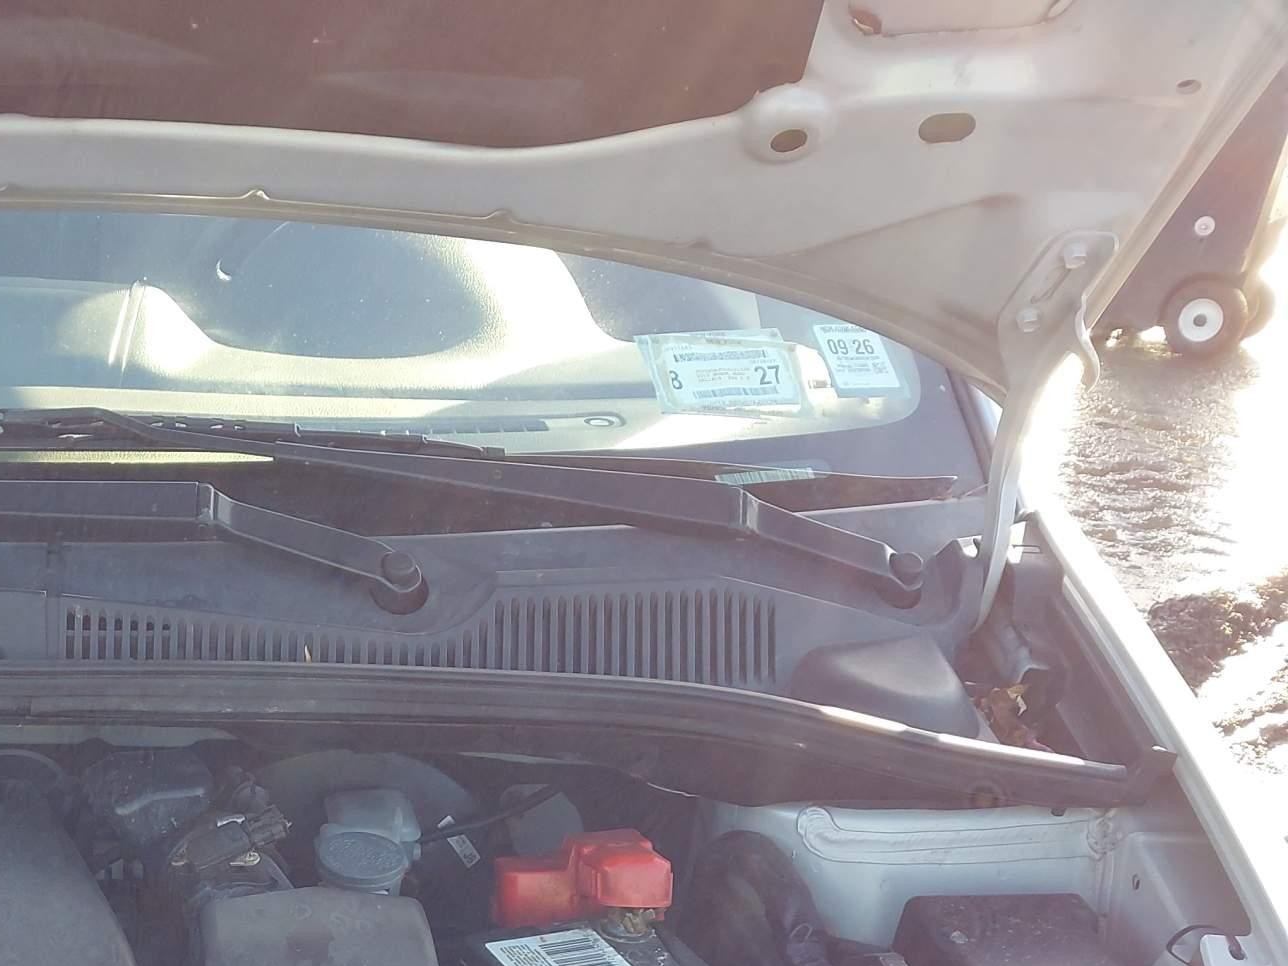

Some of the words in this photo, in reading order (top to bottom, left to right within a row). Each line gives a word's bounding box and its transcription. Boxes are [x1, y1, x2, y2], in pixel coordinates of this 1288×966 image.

[827, 339, 849, 355] 09
[853, 339, 874, 354] 26
[754, 364, 780, 385] 27
